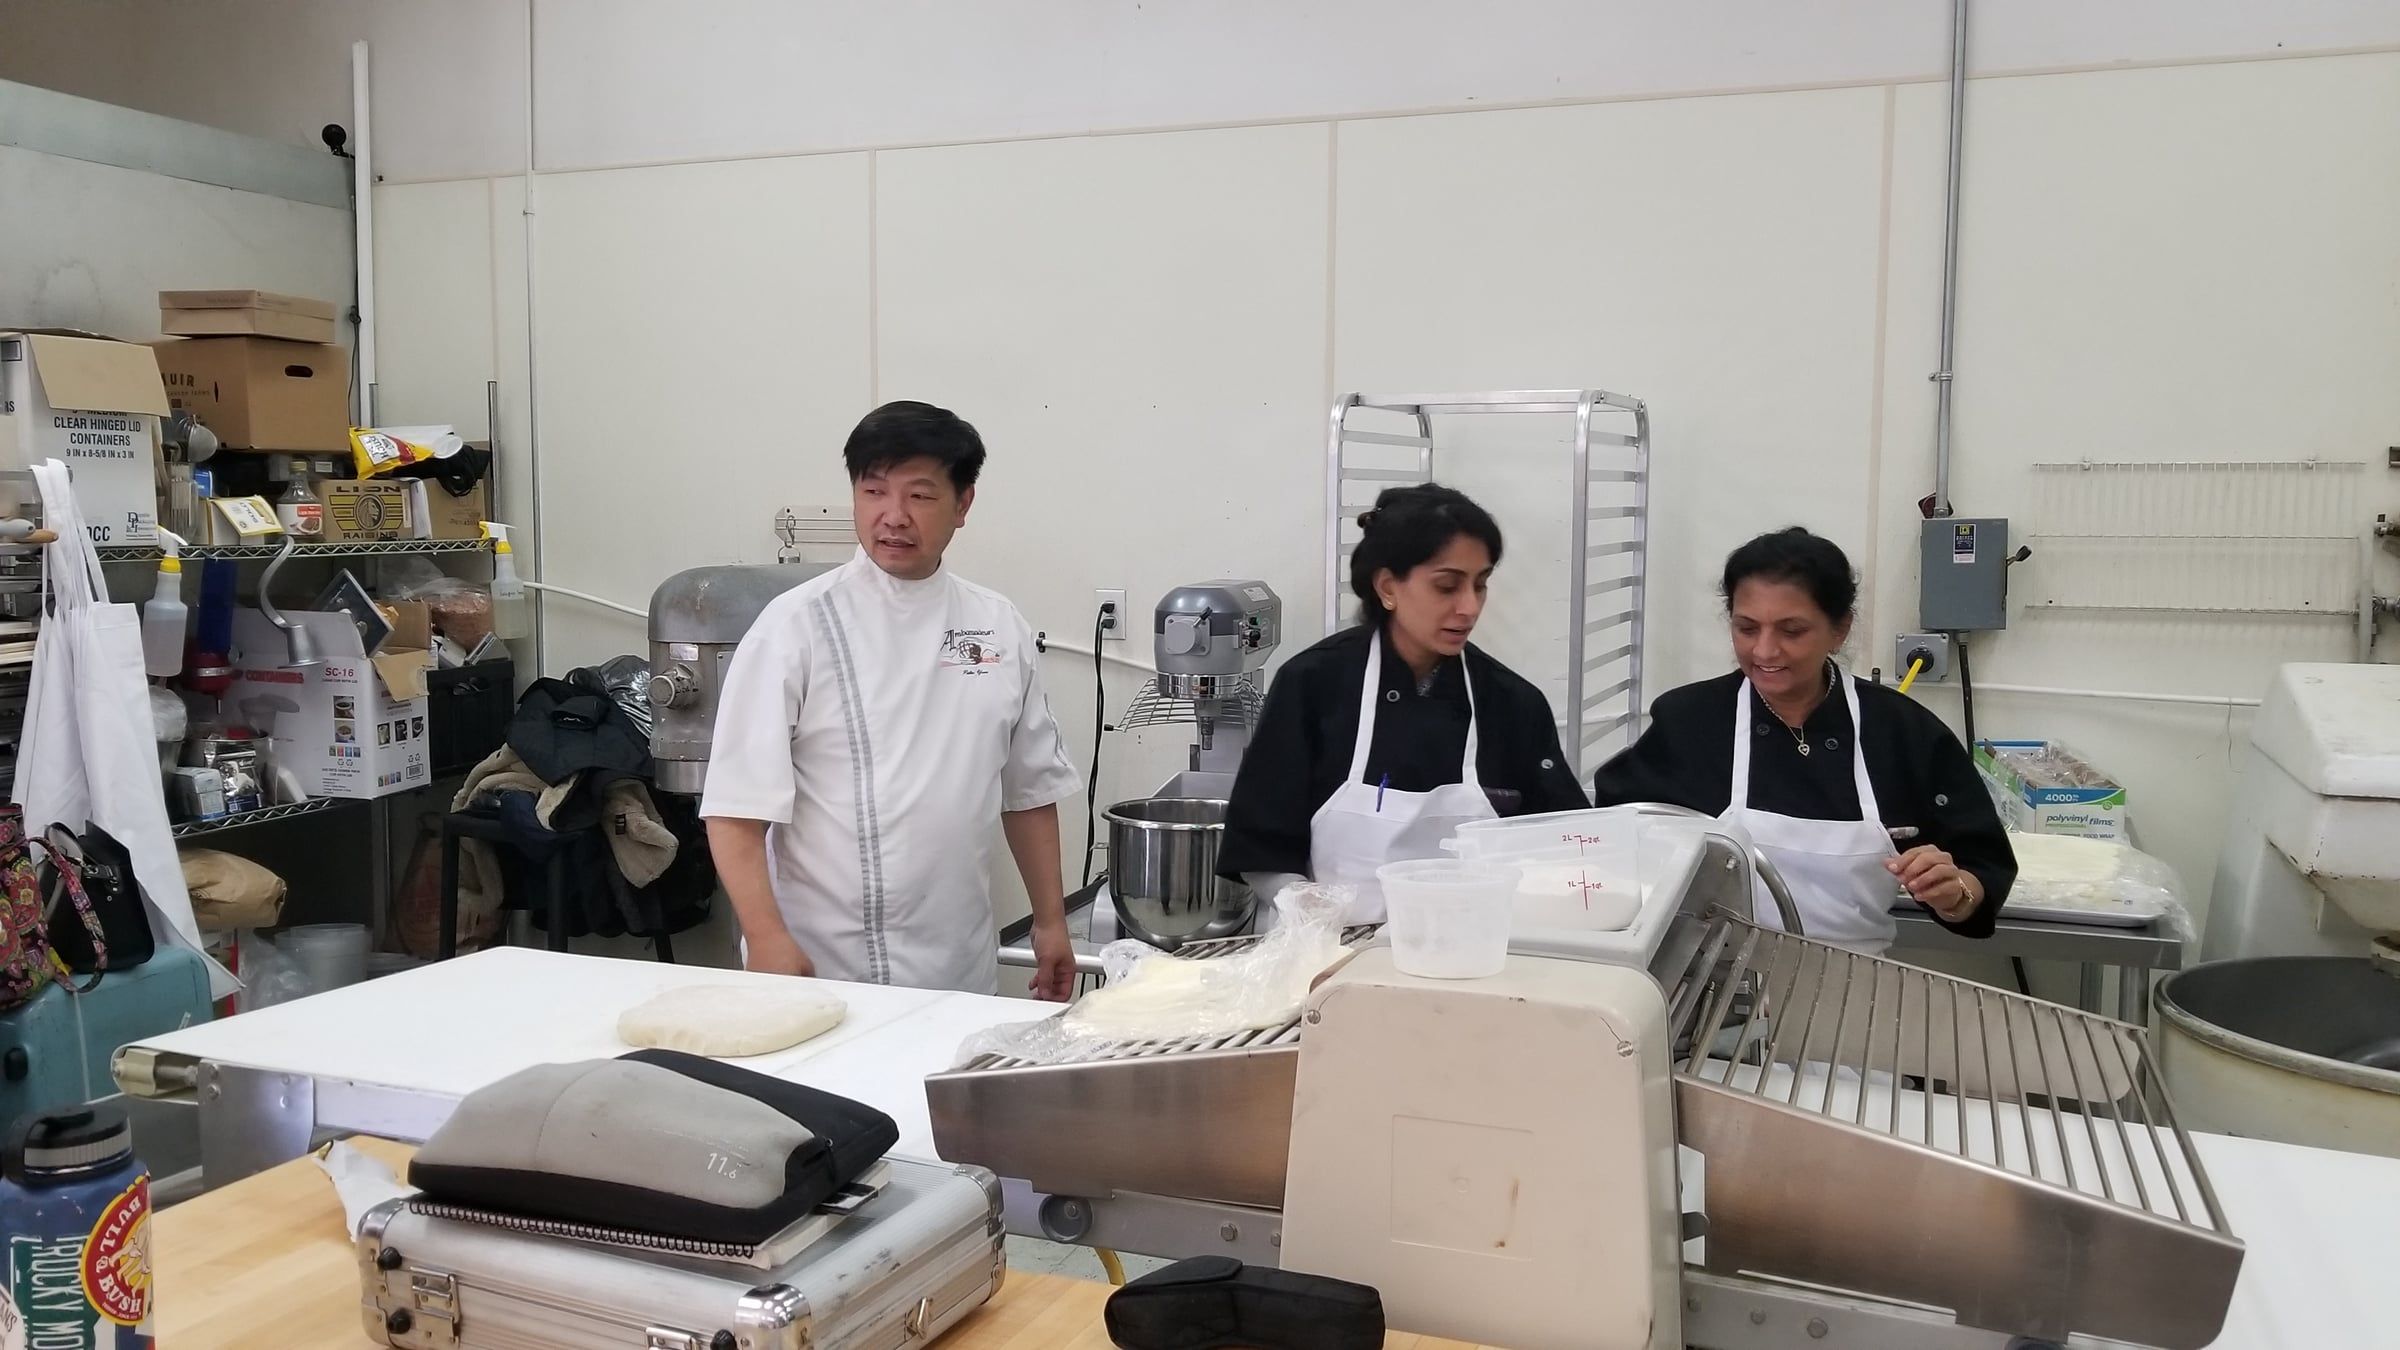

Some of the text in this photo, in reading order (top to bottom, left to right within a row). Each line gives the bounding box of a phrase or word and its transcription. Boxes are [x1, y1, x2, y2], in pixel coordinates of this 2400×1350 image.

[54, 416, 141, 432] CLEAR HINGED LID
[70, 432, 131, 446] CONTAINERS
[66, 448, 71, 456] 9
[73, 449, 81, 457] IN
[108, 450, 116, 458] IN
[122, 450, 127, 458] 3
[325, 667, 354, 677] SC-16
[2045, 793, 2072, 802] 4000
[2046, 814, 2088, 823] polyvinyl
[99, 1195, 141, 1252] BULL
[99, 1273, 142, 1313] BUSH
